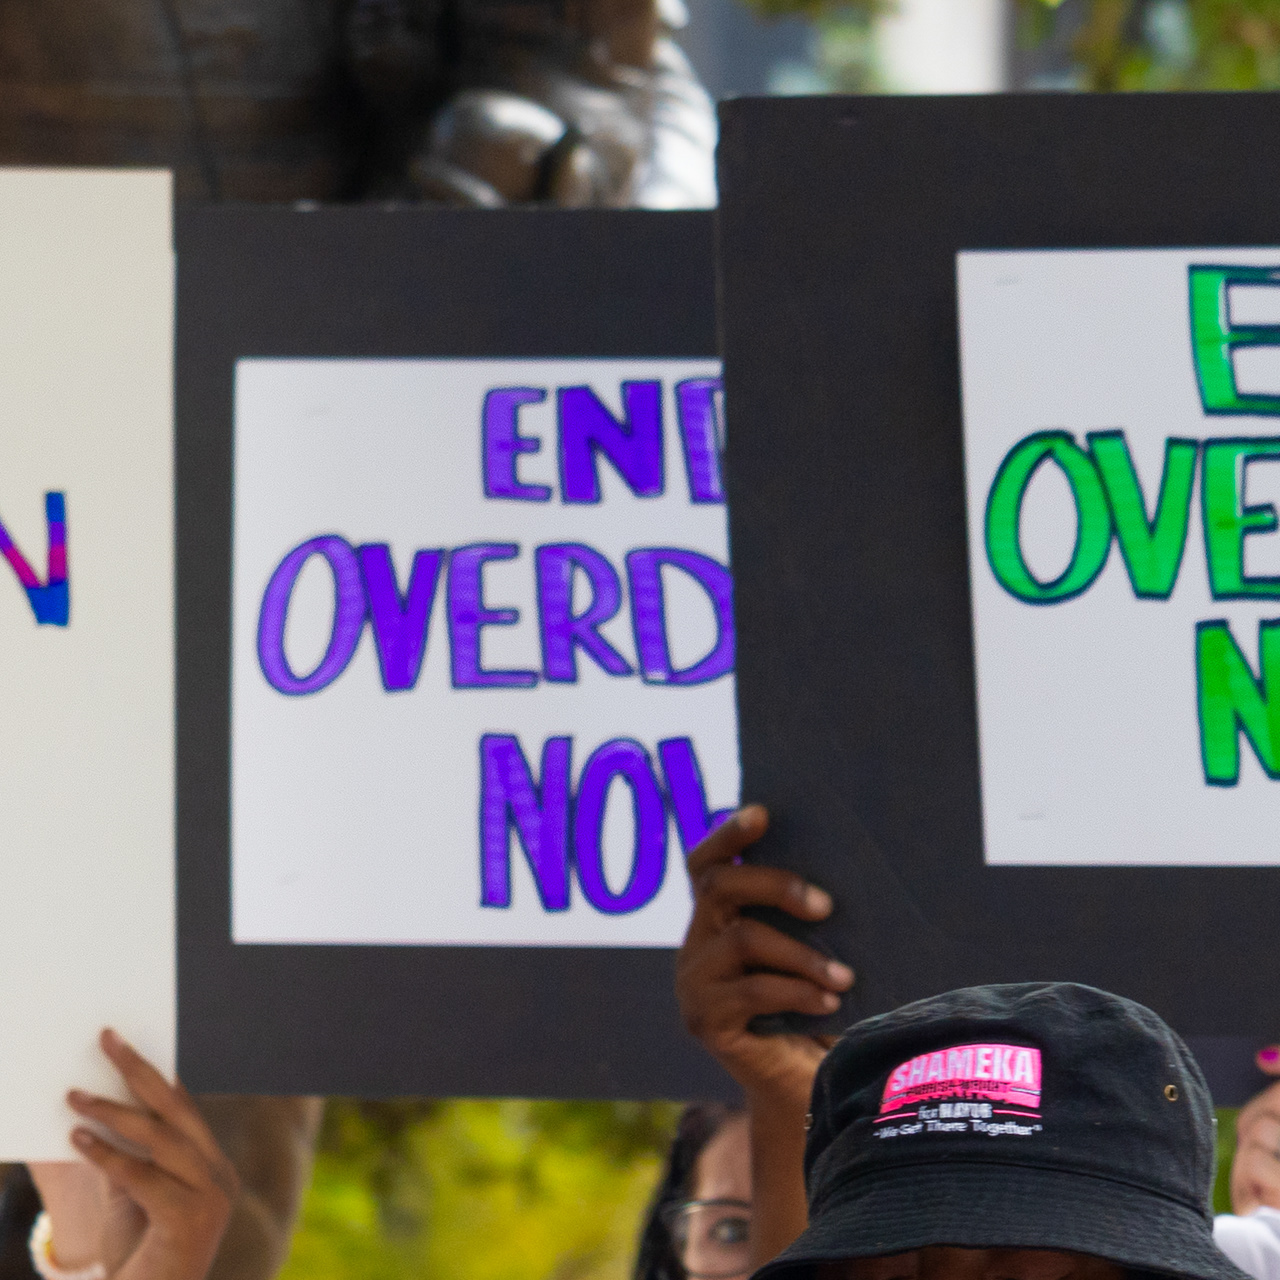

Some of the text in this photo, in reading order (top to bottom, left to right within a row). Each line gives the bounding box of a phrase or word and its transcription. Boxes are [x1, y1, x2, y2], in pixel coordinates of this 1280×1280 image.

[257, 534, 737, 697] OVERD
[892, 1048, 1033, 1092] SHAMEKA
[924, 1119, 968, 1132] There
